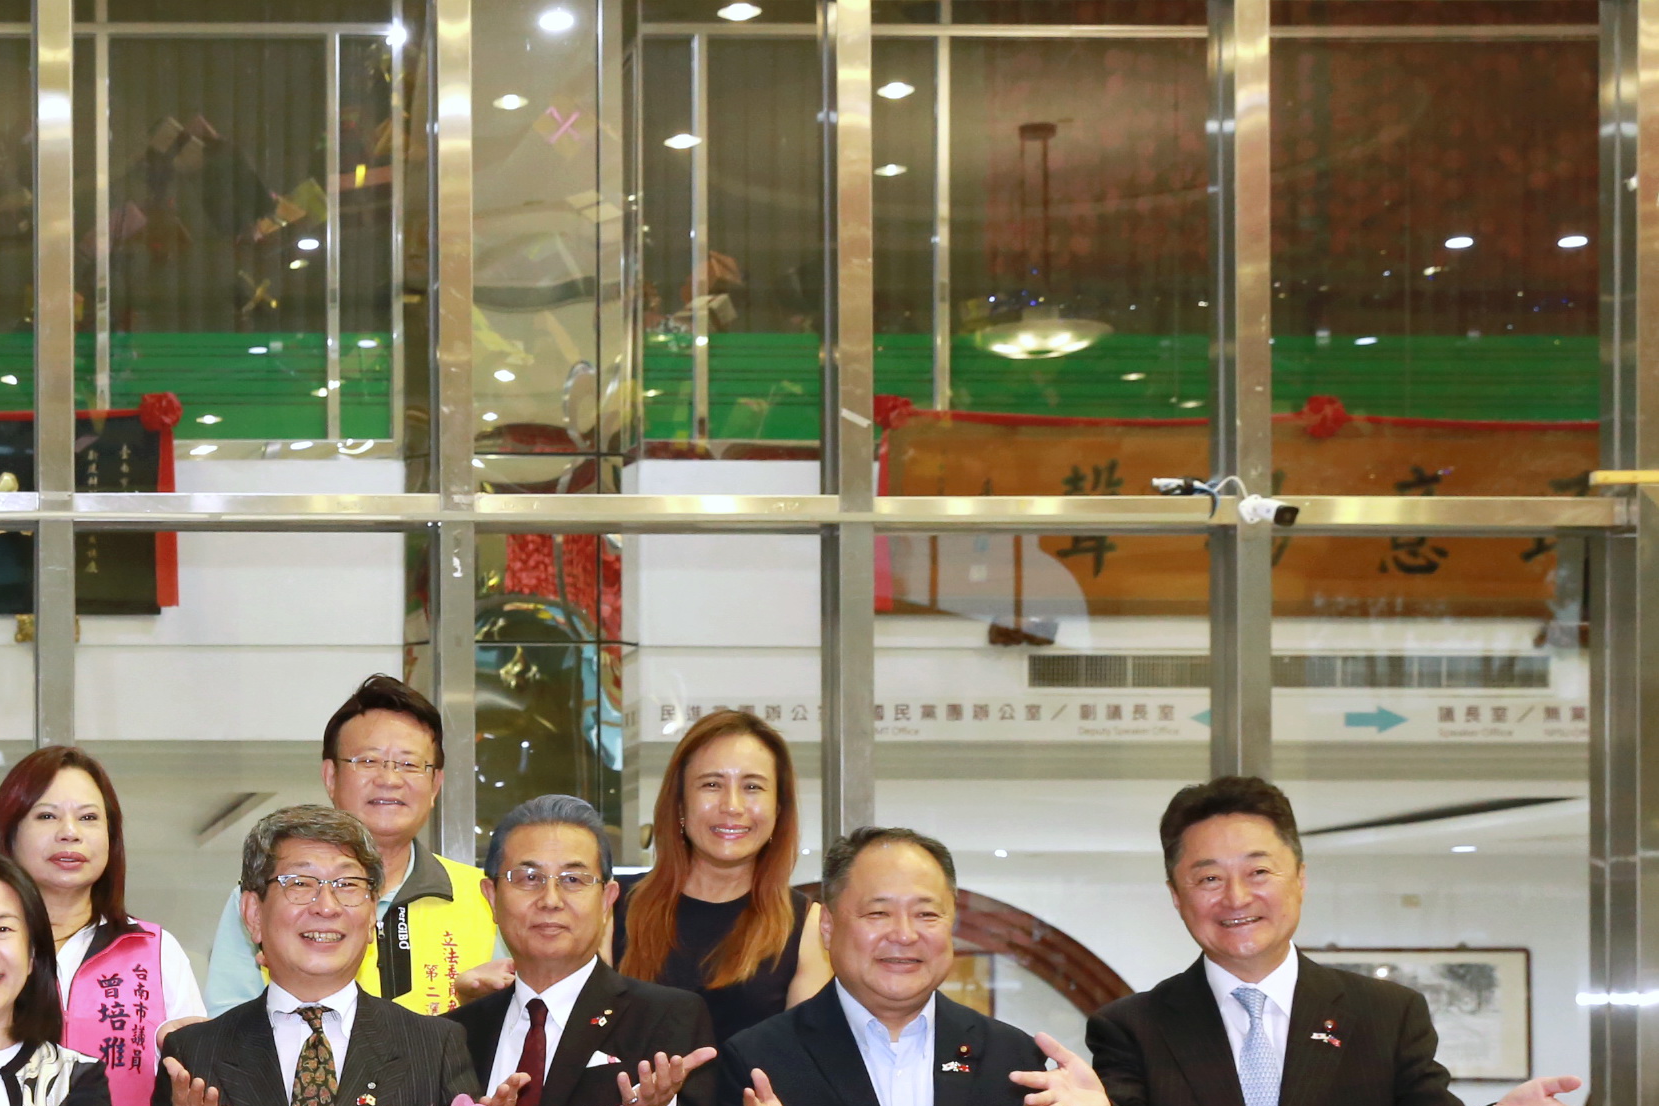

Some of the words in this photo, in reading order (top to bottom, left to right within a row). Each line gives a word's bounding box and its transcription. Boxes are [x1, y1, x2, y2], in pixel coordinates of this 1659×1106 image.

[97, 973, 130, 1070] 曾培雅
[128, 963, 150, 1074] 台南市議員
